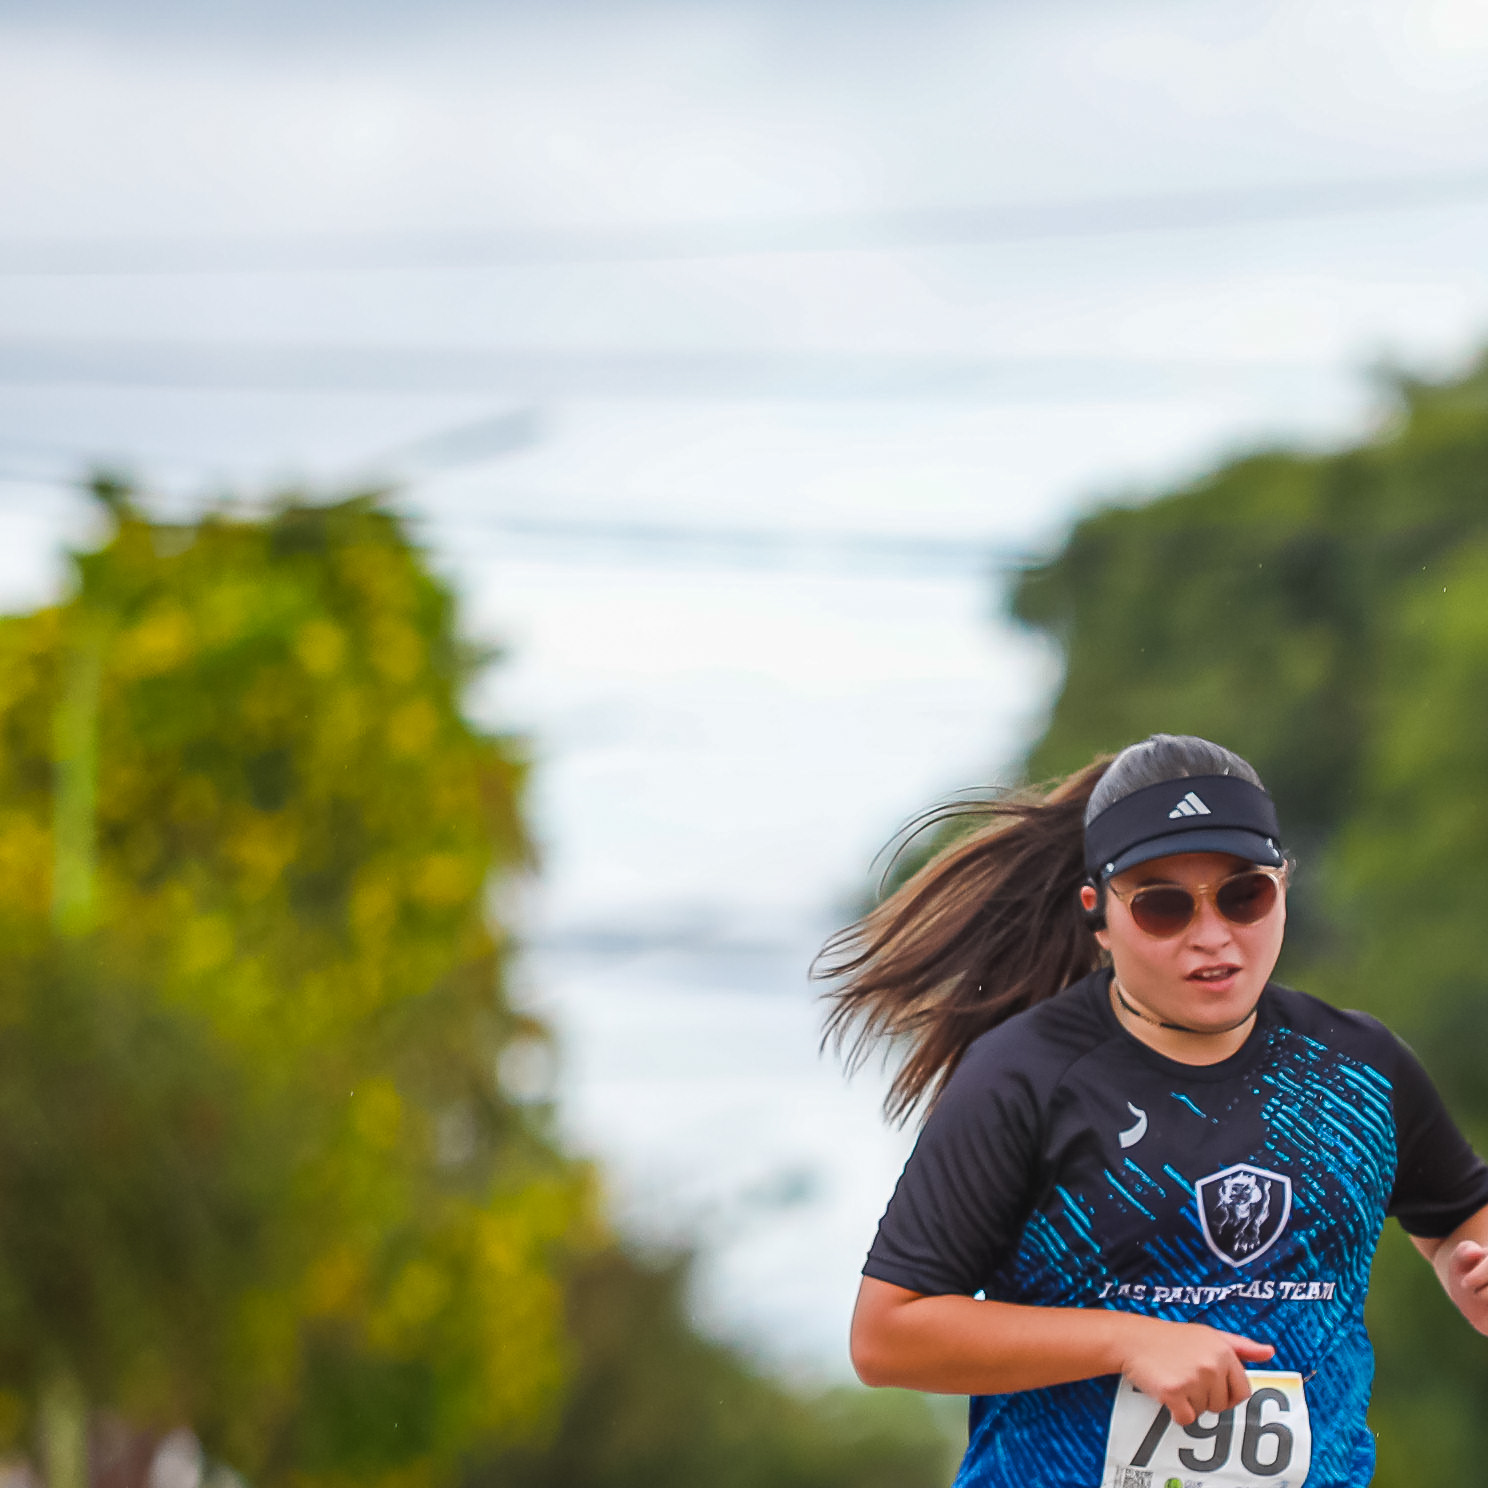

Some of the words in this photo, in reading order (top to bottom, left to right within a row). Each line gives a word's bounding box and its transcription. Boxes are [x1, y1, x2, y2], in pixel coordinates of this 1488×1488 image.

[1098, 1282, 1147, 1302] LAS
[1278, 1281, 1336, 1301] TEAM
[1129, 1387, 1294, 1477] 796
